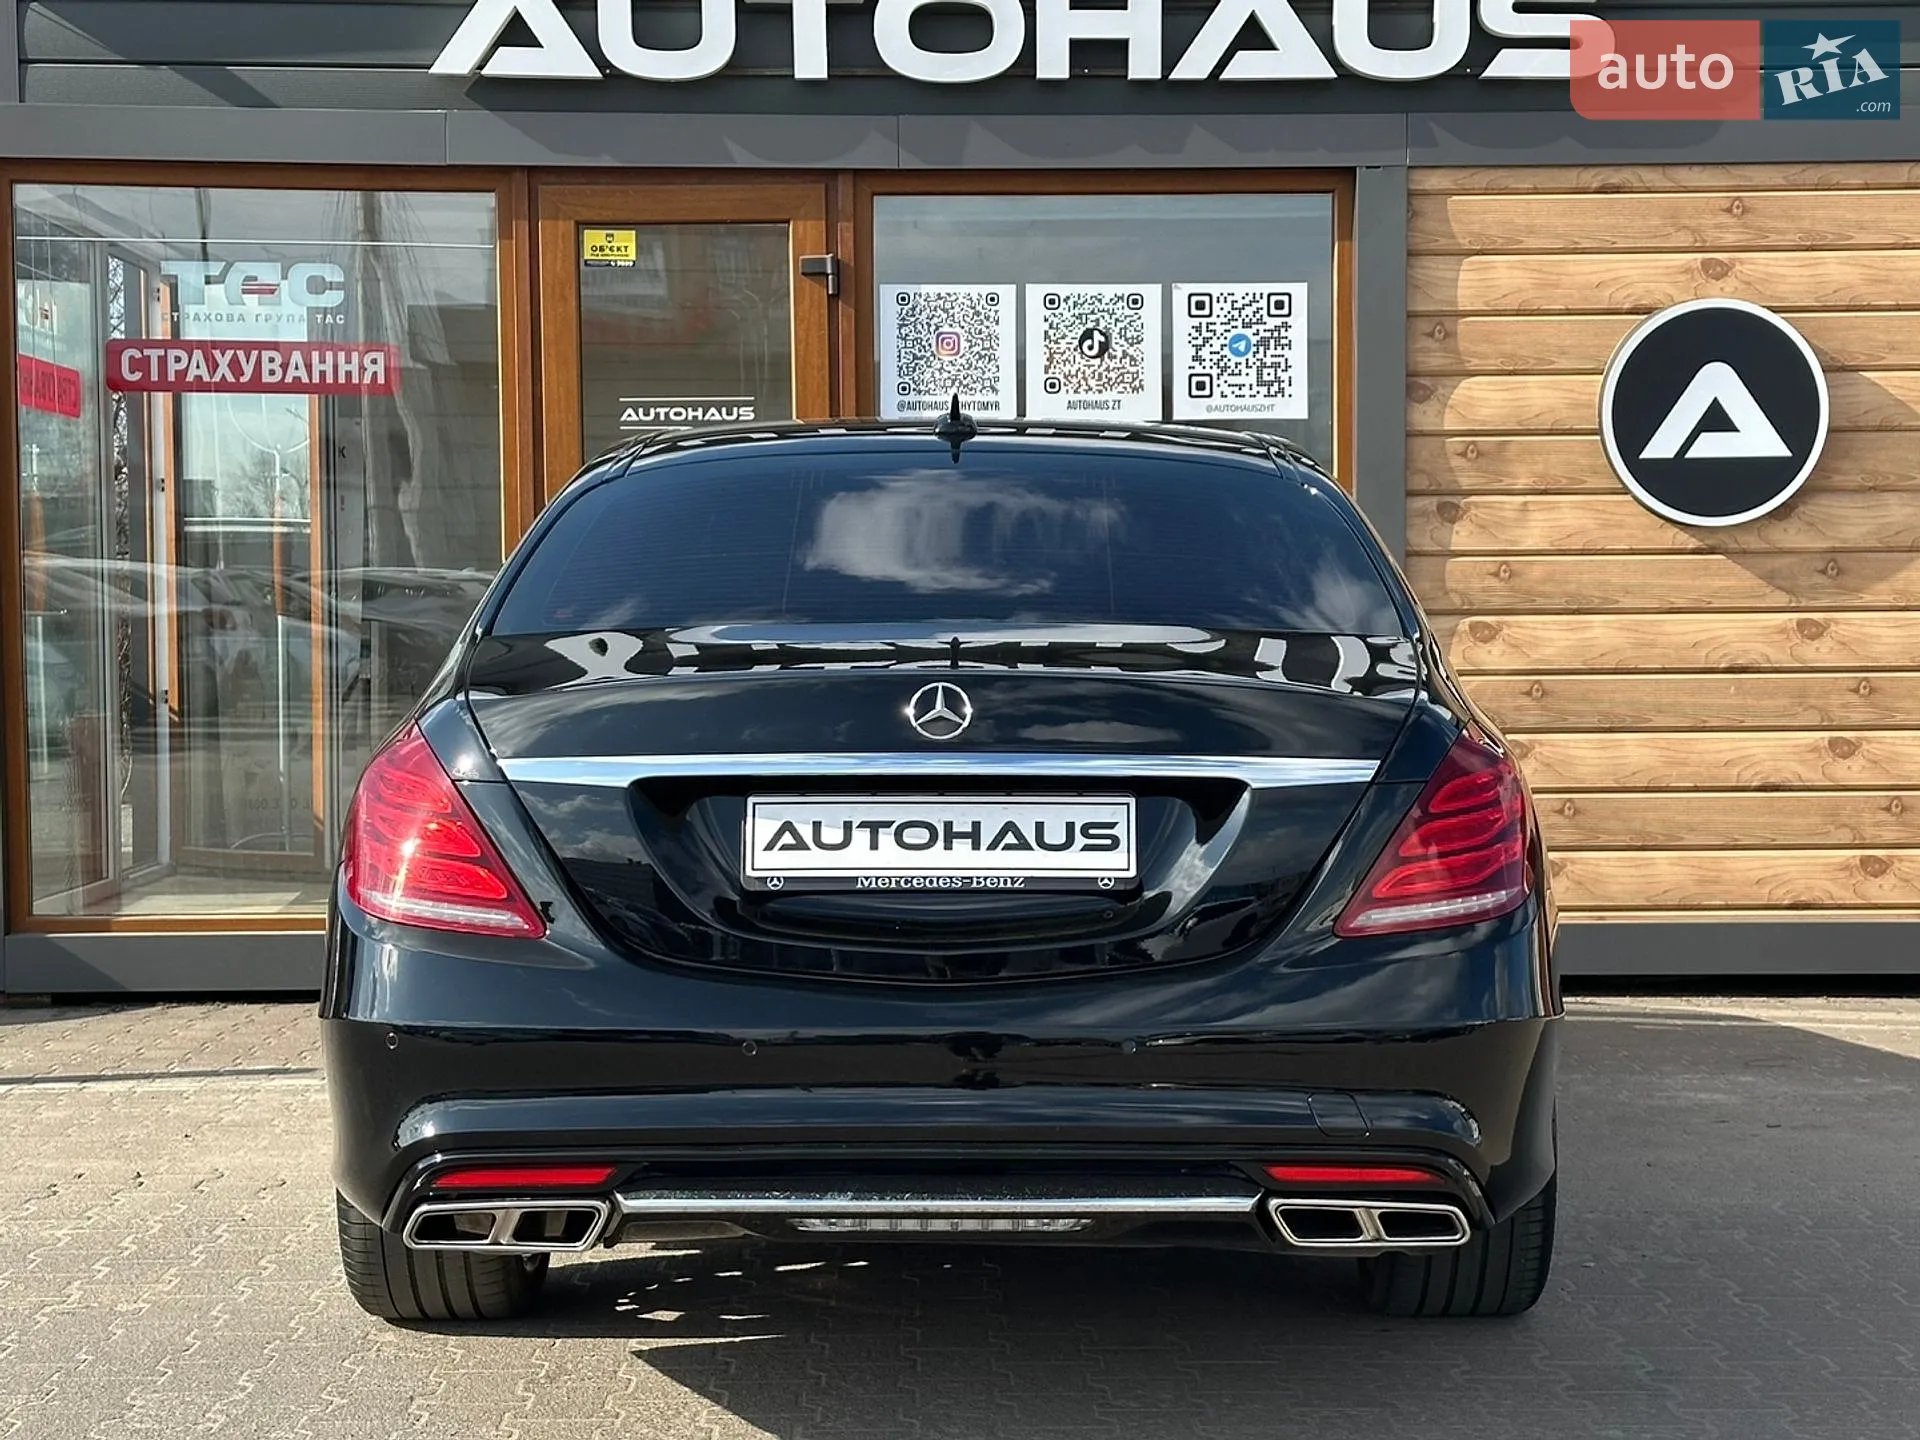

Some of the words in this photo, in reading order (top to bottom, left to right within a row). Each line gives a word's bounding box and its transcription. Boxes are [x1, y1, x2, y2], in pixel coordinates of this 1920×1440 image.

[429, 0, 1616, 84] AUTOHAUS
[315, 313, 346, 326] ТАС
[119, 347, 386, 386] СТРАХУВАННЯ
[618, 405, 756, 422] AUTOHAUS
[1066, 399, 1110, 411] AUTOHAUS
[1111, 399, 1122, 411] ZT
[761, 819, 1121, 853] AUTOHAUS
